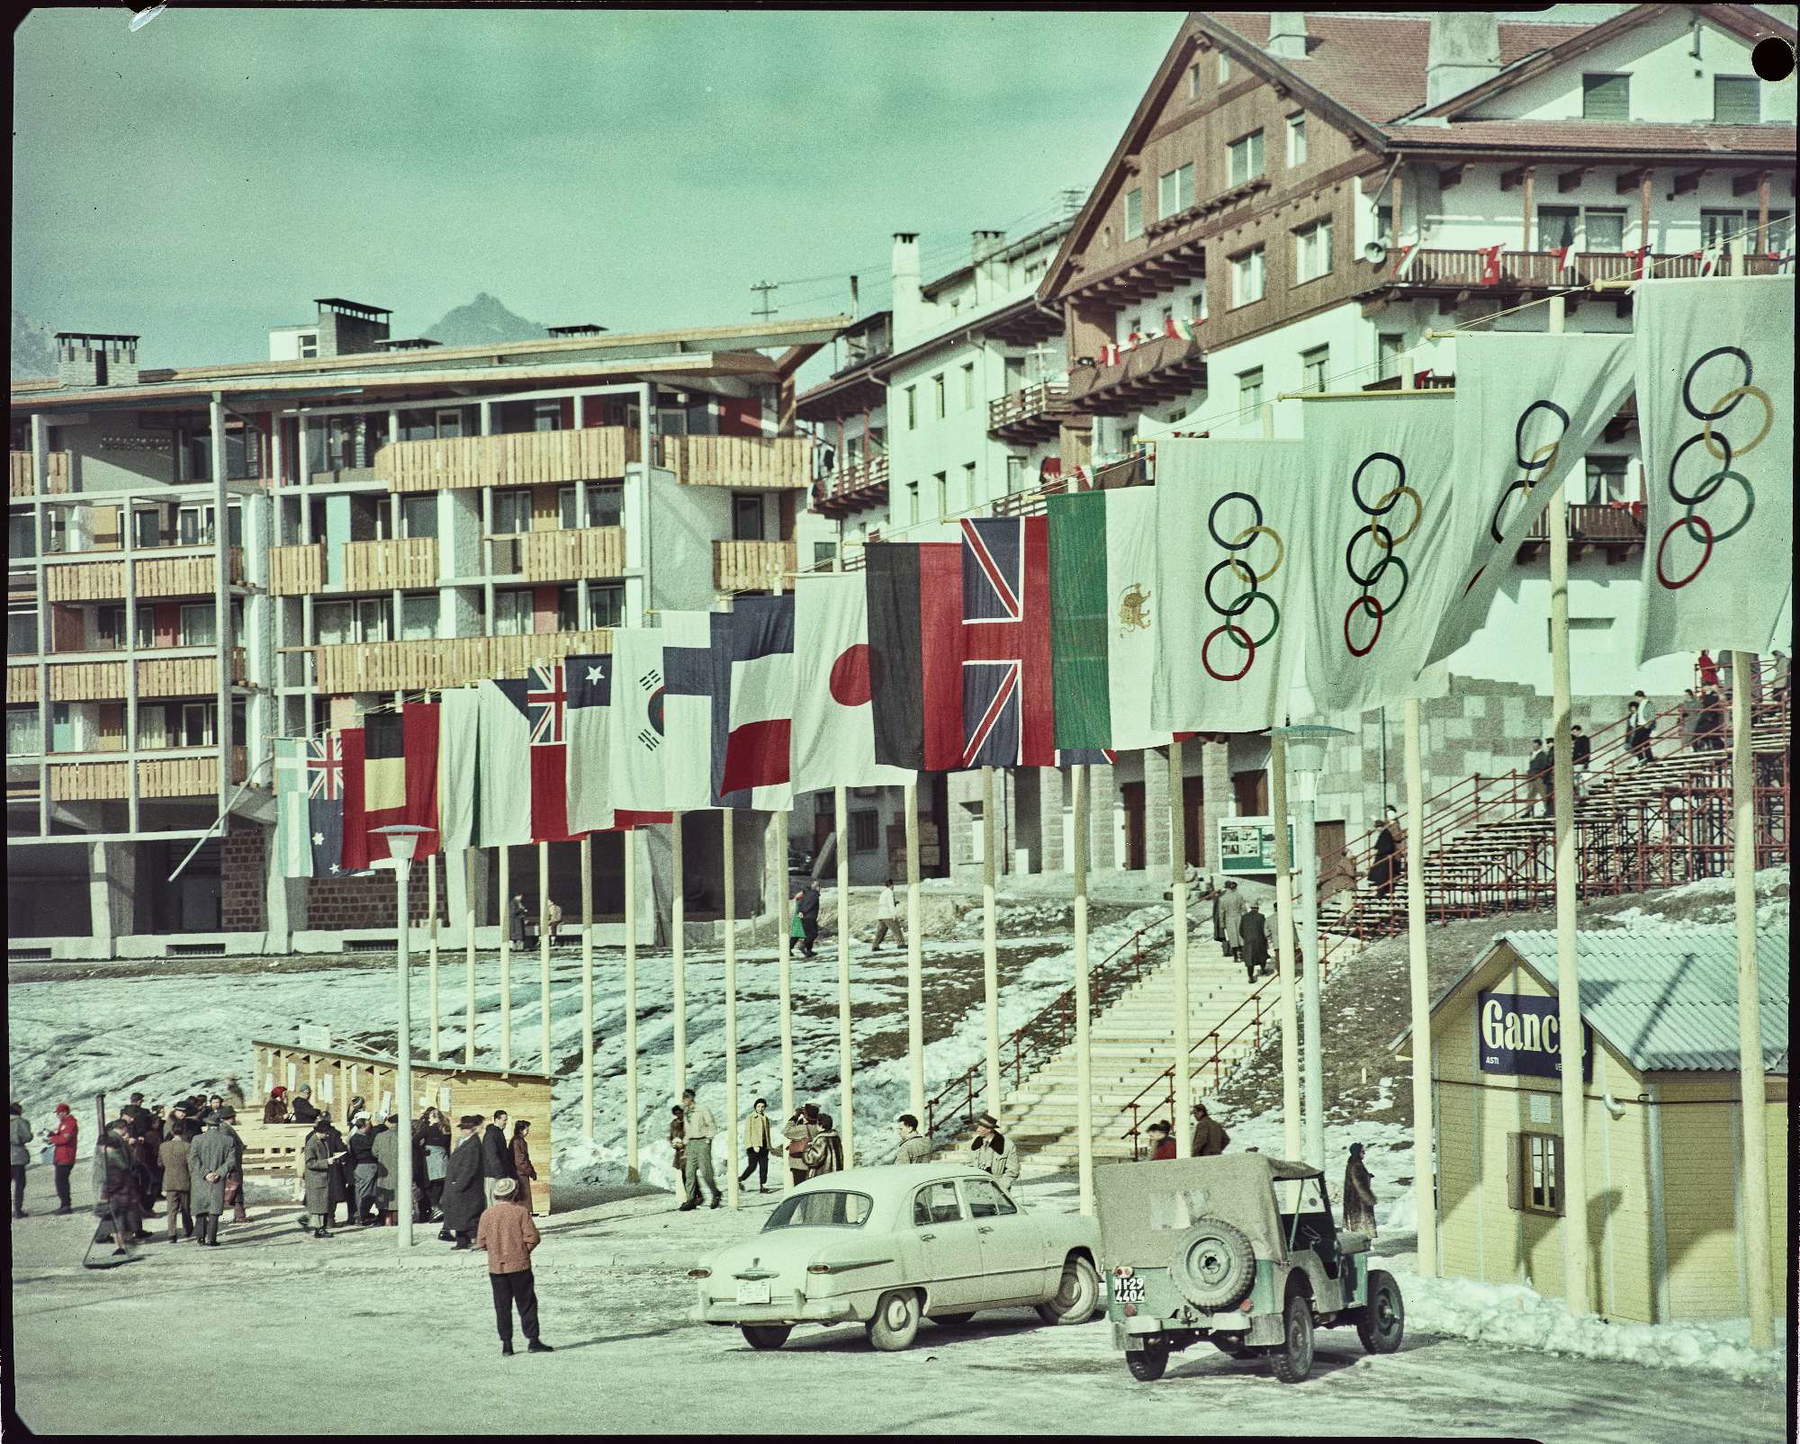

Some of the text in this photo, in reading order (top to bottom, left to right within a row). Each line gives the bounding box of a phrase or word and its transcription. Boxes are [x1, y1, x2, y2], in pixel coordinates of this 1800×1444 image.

[1482, 999, 1587, 1056] Ganc
[1485, 1056, 1500, 1065] ASTI
[1115, 1290, 1145, 1302] 4404
